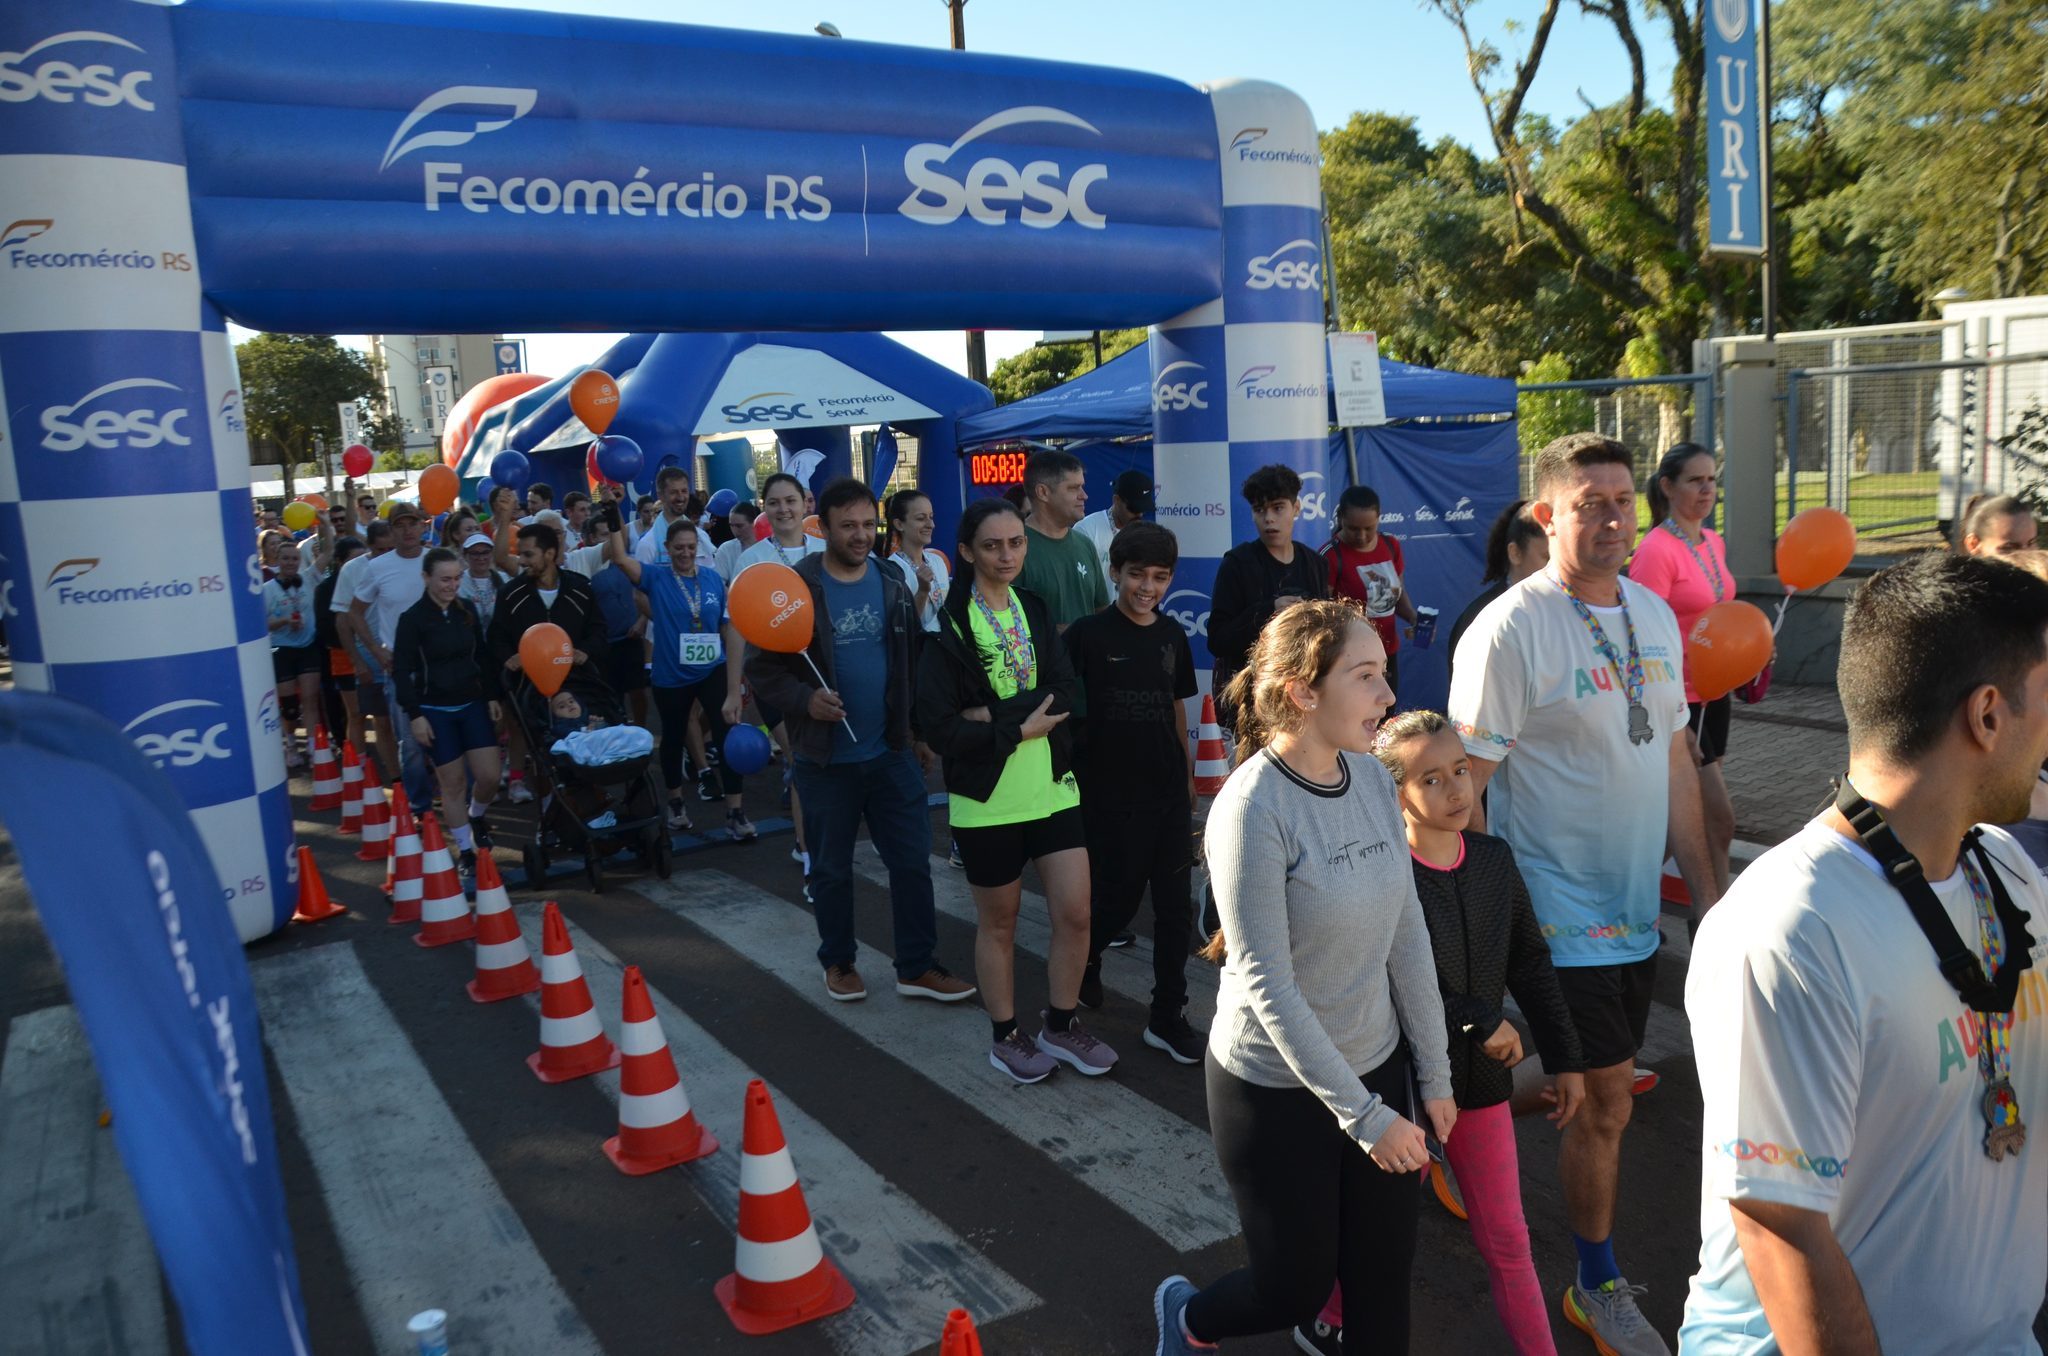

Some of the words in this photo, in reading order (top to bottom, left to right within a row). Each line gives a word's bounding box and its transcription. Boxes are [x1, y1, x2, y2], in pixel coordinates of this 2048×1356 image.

[1717, 55, 1749, 240] URI
[423, 162, 748, 219] Fecomércio
[764, 174, 831, 222] RS
[898, 142, 1108, 229] Sesc
[12, 248, 155, 270] Fecomércio
[162, 251, 192, 272] RS
[1245, 256, 1320, 291] Sesc
[721, 403, 813, 424] Sesc
[818, 393, 895, 407] Fecomércio
[826, 408, 868, 418] Senac
[40, 405, 192, 452] Sesc
[1205, 503, 1226, 517] RS
[60, 580, 192, 605] Fecomércio
[200, 575, 225, 594] RS
[770, 598, 805, 629] CRESOL
[686, 645, 716, 662] 520
[133, 721, 232, 769] esc
[241, 875, 266, 896] RS
